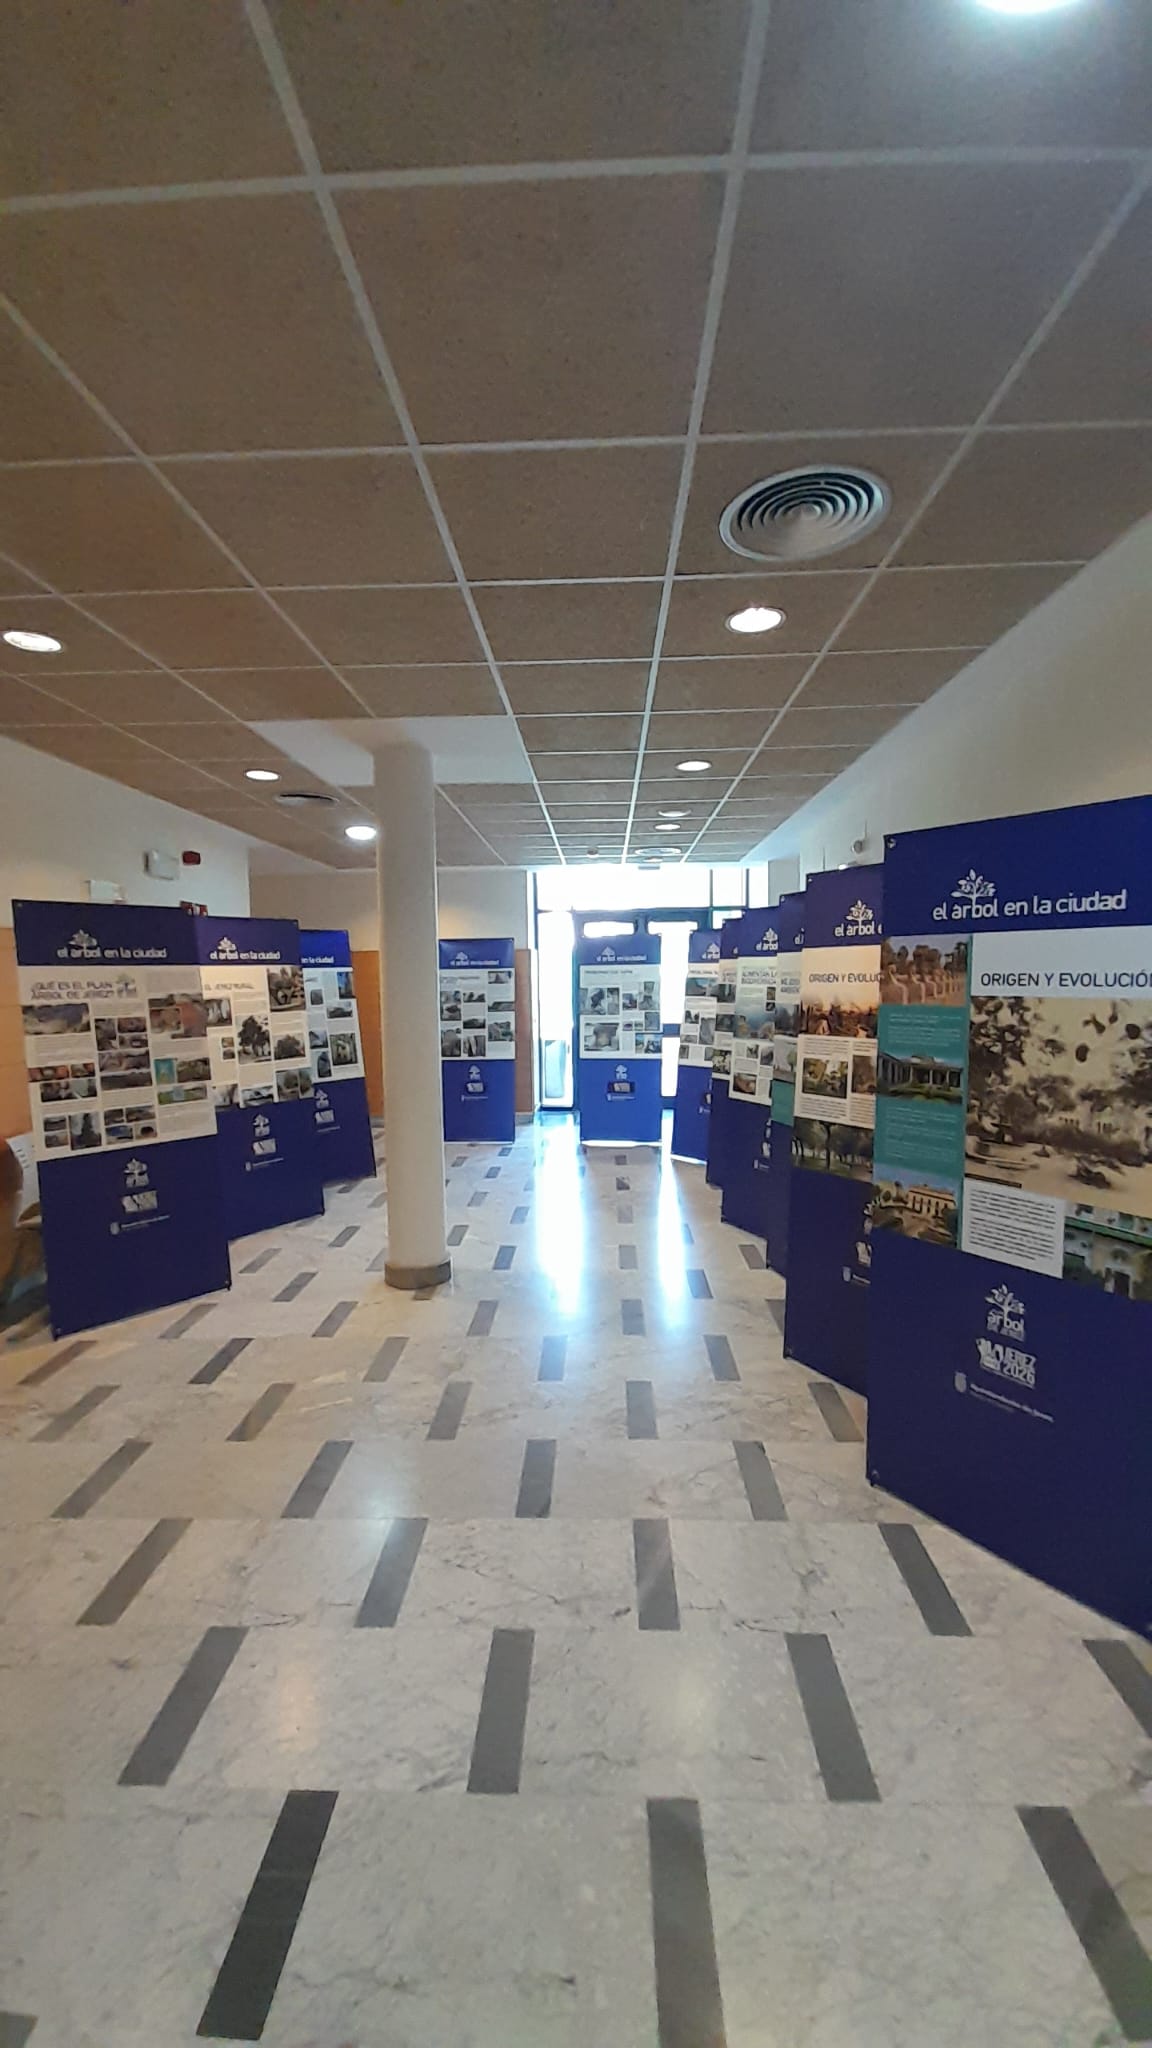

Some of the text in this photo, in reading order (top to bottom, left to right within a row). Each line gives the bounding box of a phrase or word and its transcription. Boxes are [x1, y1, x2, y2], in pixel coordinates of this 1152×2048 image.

[932, 901, 948, 921] el
[1004, 901, 1028, 916] en
[1033, 896, 1051, 914] la
[1056, 889, 1127, 913] ciudad
[834, 923, 844, 936] el
[57, 948, 69, 959] el
[104, 949, 119, 959] en
[120, 947, 132, 959] la
[133, 947, 168, 959] ciudad
[808, 972, 840, 984] ORIGEN
[841, 972, 847, 983] Y
[981, 968, 1152, 988] ORIGEN Y EVOLUCIÓ
[1002, 1361, 1036, 1387] 2026
